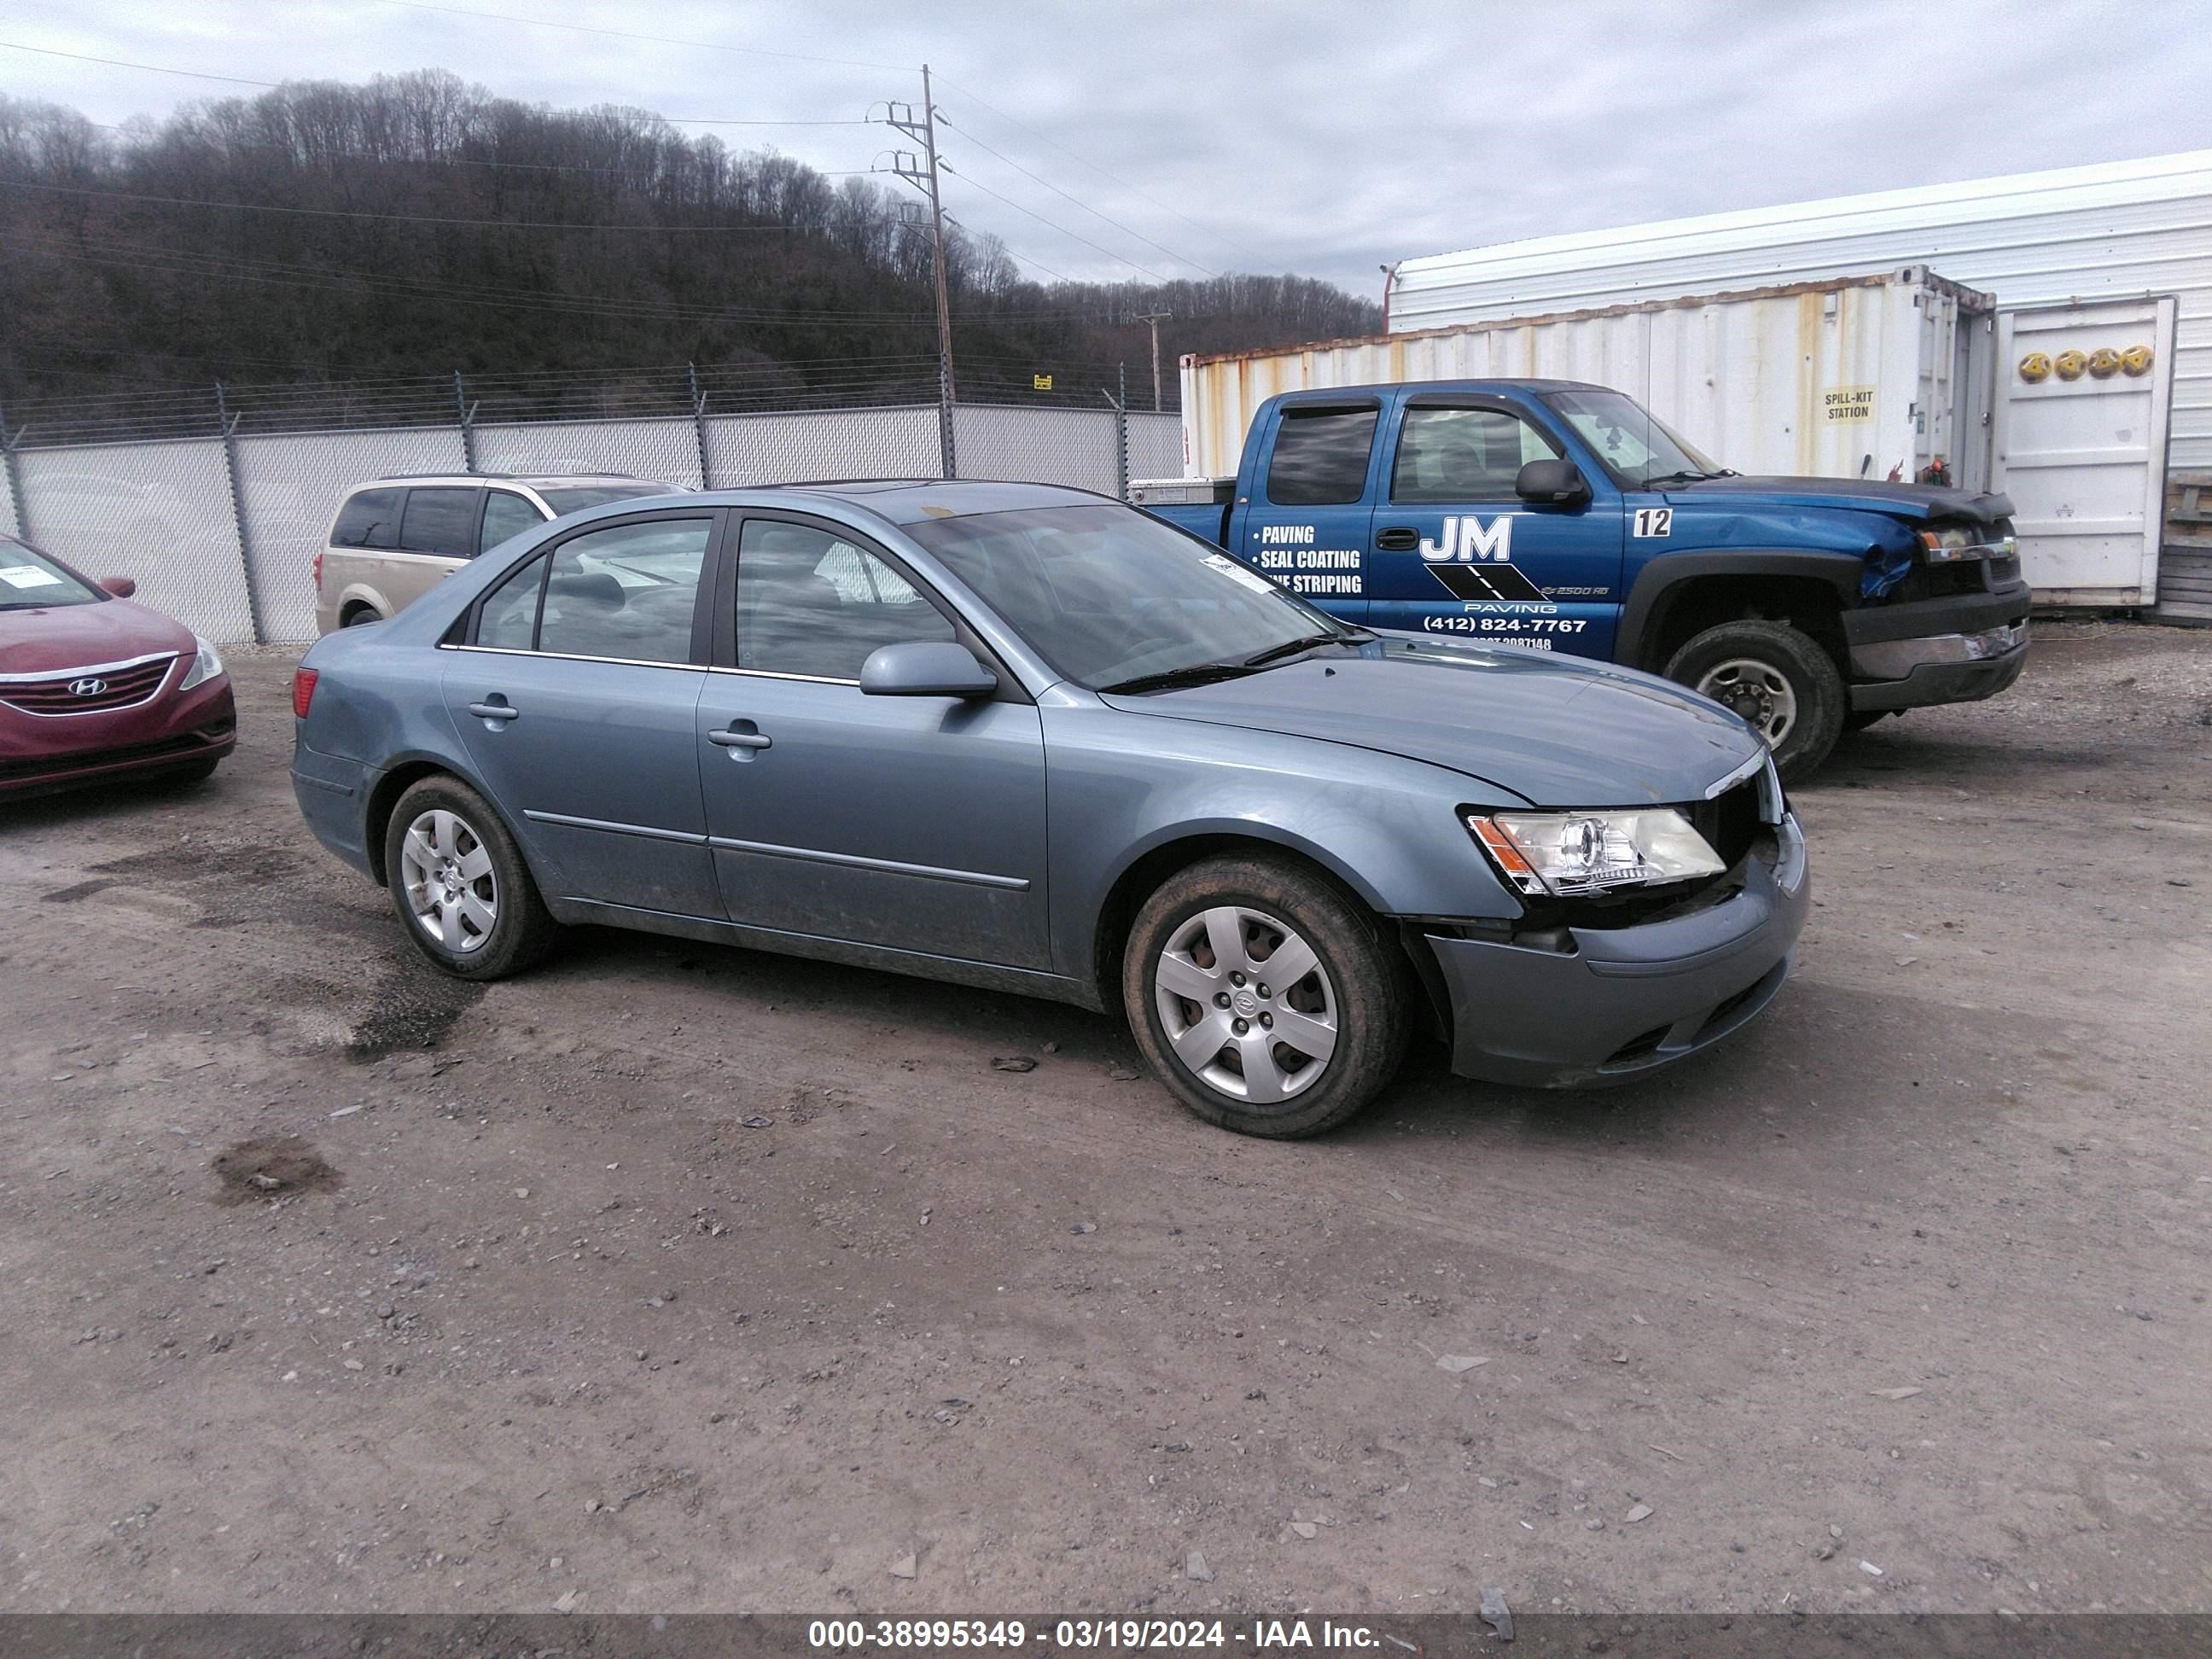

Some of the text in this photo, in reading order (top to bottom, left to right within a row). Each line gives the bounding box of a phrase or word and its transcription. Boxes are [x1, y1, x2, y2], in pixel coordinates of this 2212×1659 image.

[1825, 392, 1873, 405] SPILL-KIT
[1828, 406, 1869, 419] STATION
[1639, 509, 1670, 536] 12
[1261, 526, 1314, 544] PAVING
[1419, 515, 1512, 562] JM
[1260, 550, 1294, 568] SEAL
[1297, 550, 1360, 568] COATING
[1293, 575, 1362, 593] STRIPING
[1464, 603, 1557, 614] PAVING
[1423, 616, 1586, 633] (412) 824-7767
